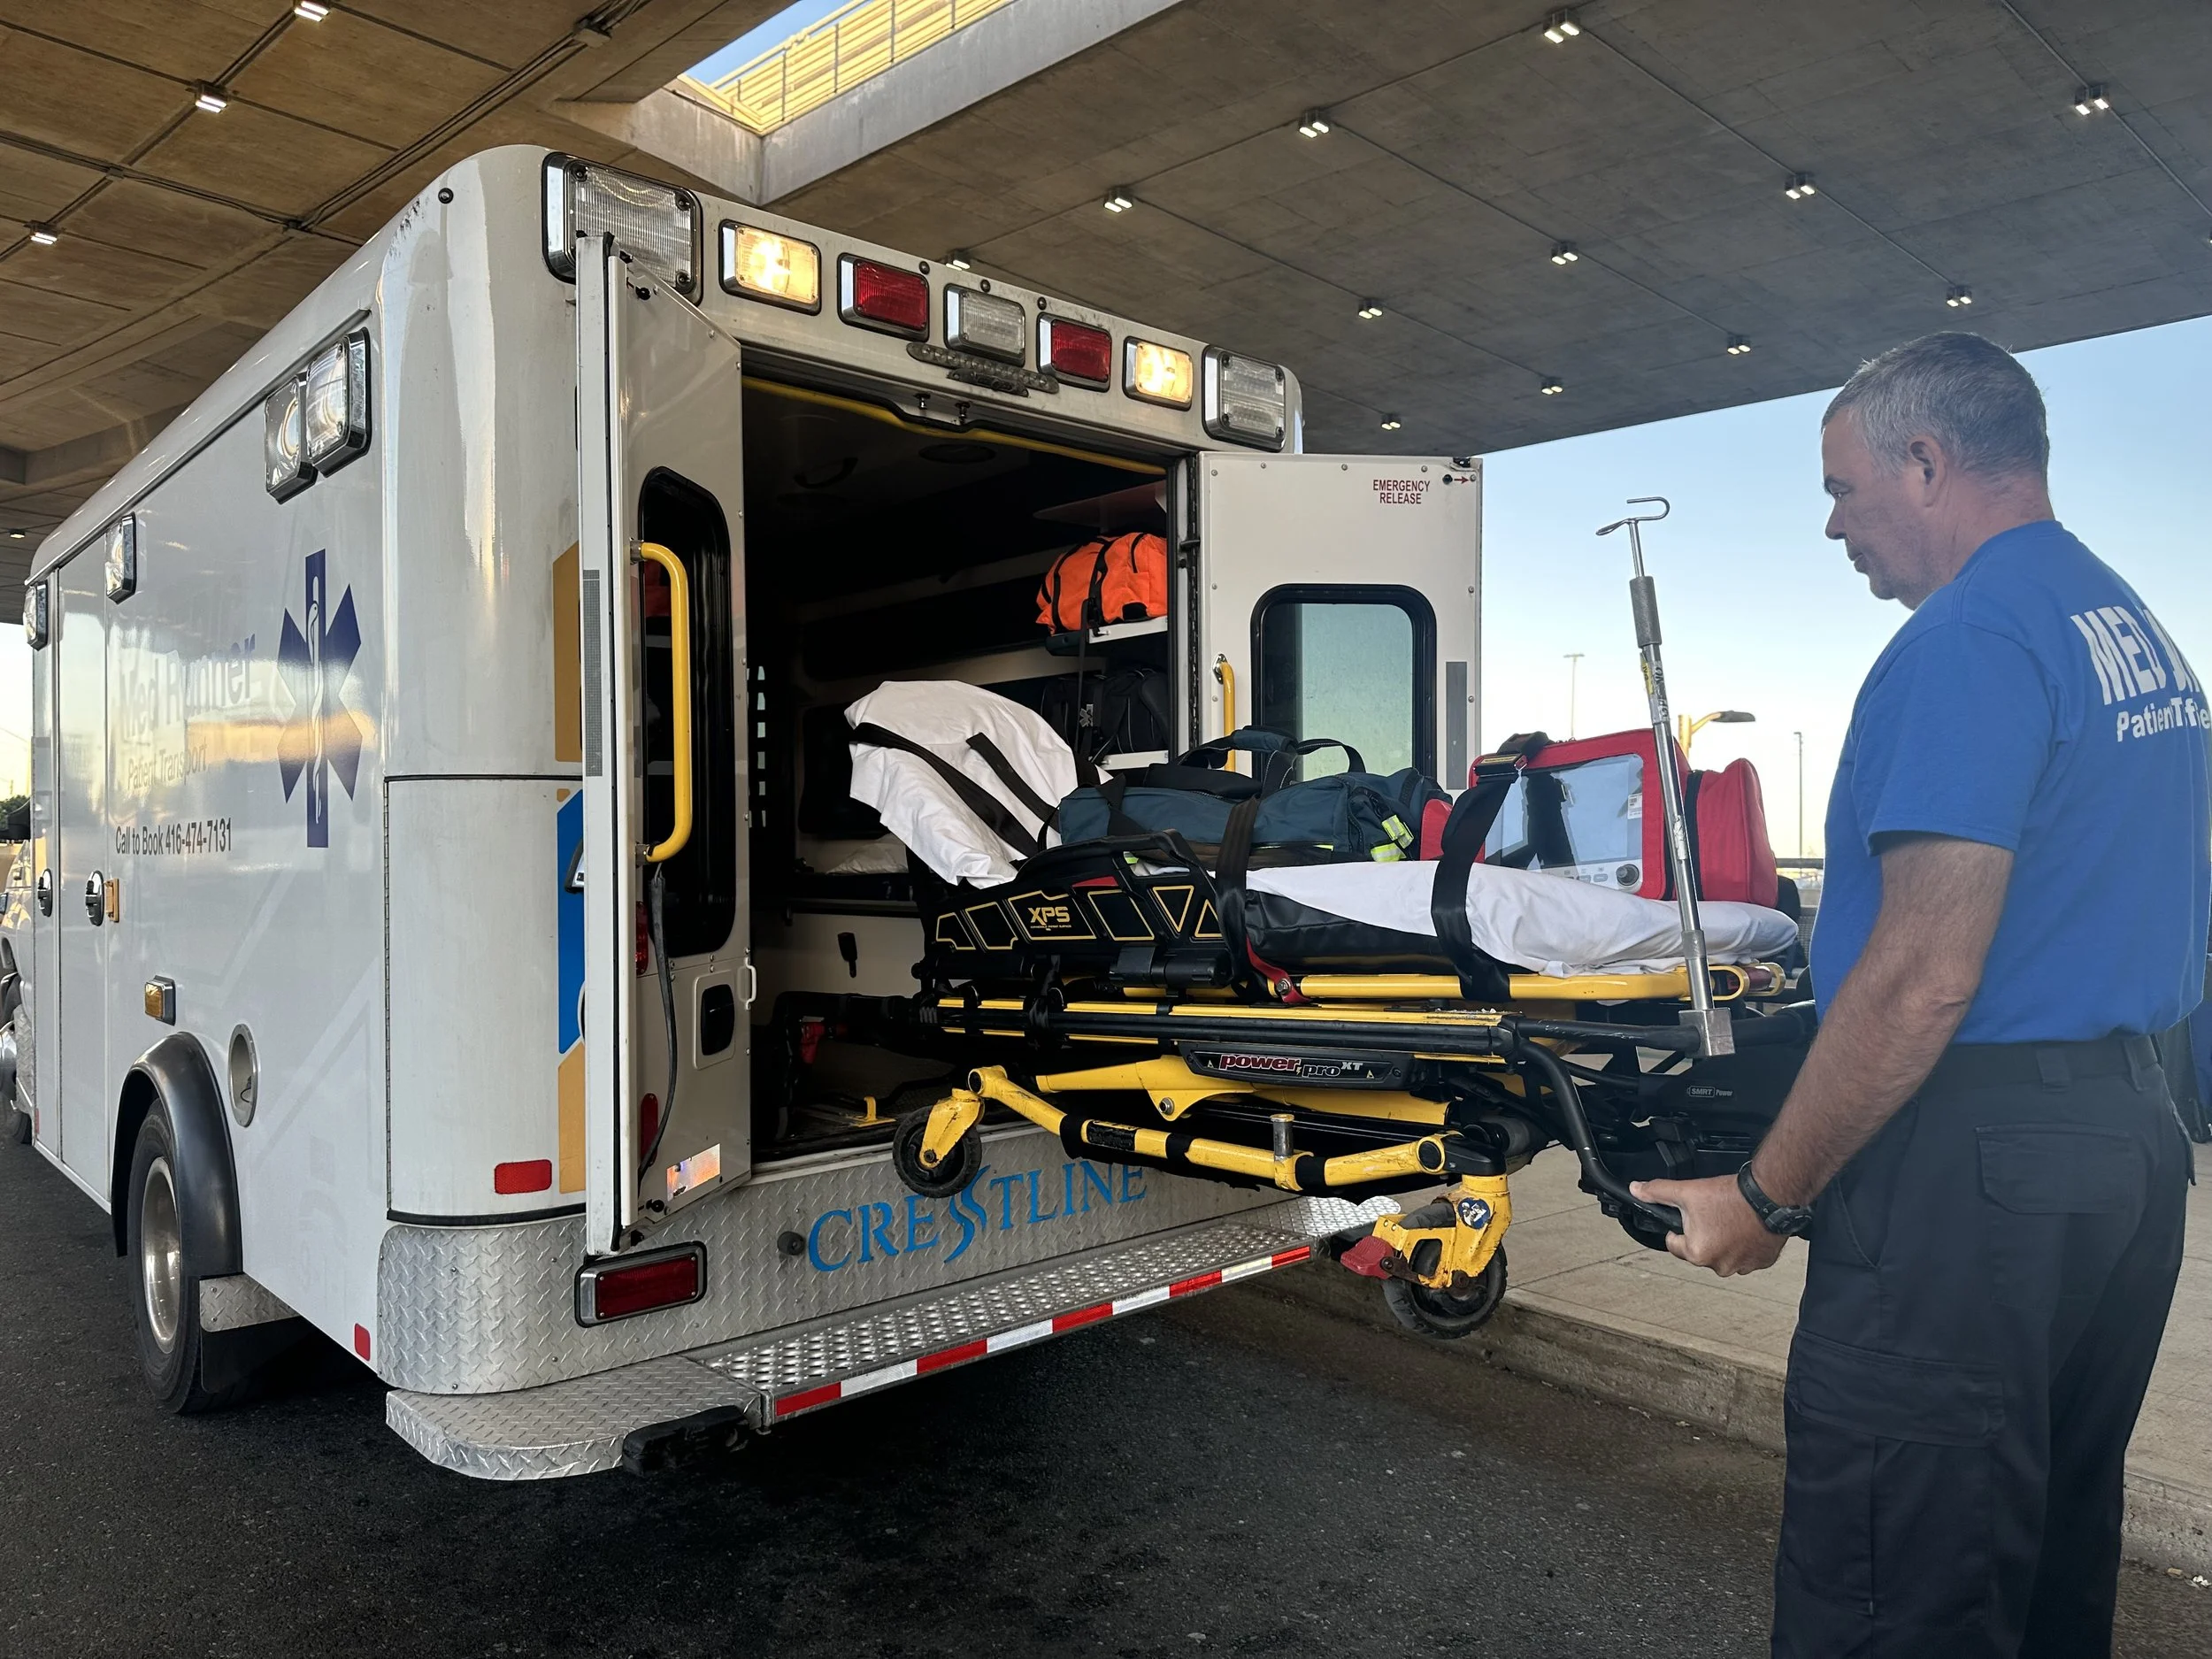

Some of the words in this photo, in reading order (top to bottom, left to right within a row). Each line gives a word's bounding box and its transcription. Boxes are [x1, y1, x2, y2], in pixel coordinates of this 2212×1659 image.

[1373, 480, 1430, 492] EMERGENCY
[1379, 492, 1421, 504] RELEASE
[2070, 605, 2166, 706] MED
[127, 753, 157, 790] Patient
[159, 736, 208, 786] Transport
[116, 826, 130, 854] Call
[132, 827, 140, 856] to
[142, 826, 164, 856] Book
[165, 818, 232, 855] 416-474-7131
[1027, 906, 1071, 926] XPS
[1219, 1053, 1302, 1071] power
[1302, 1064, 1340, 1077] pro
[1341, 1062, 1363, 1071] XT
[808, 1161, 1148, 1272] CRESTLINE
